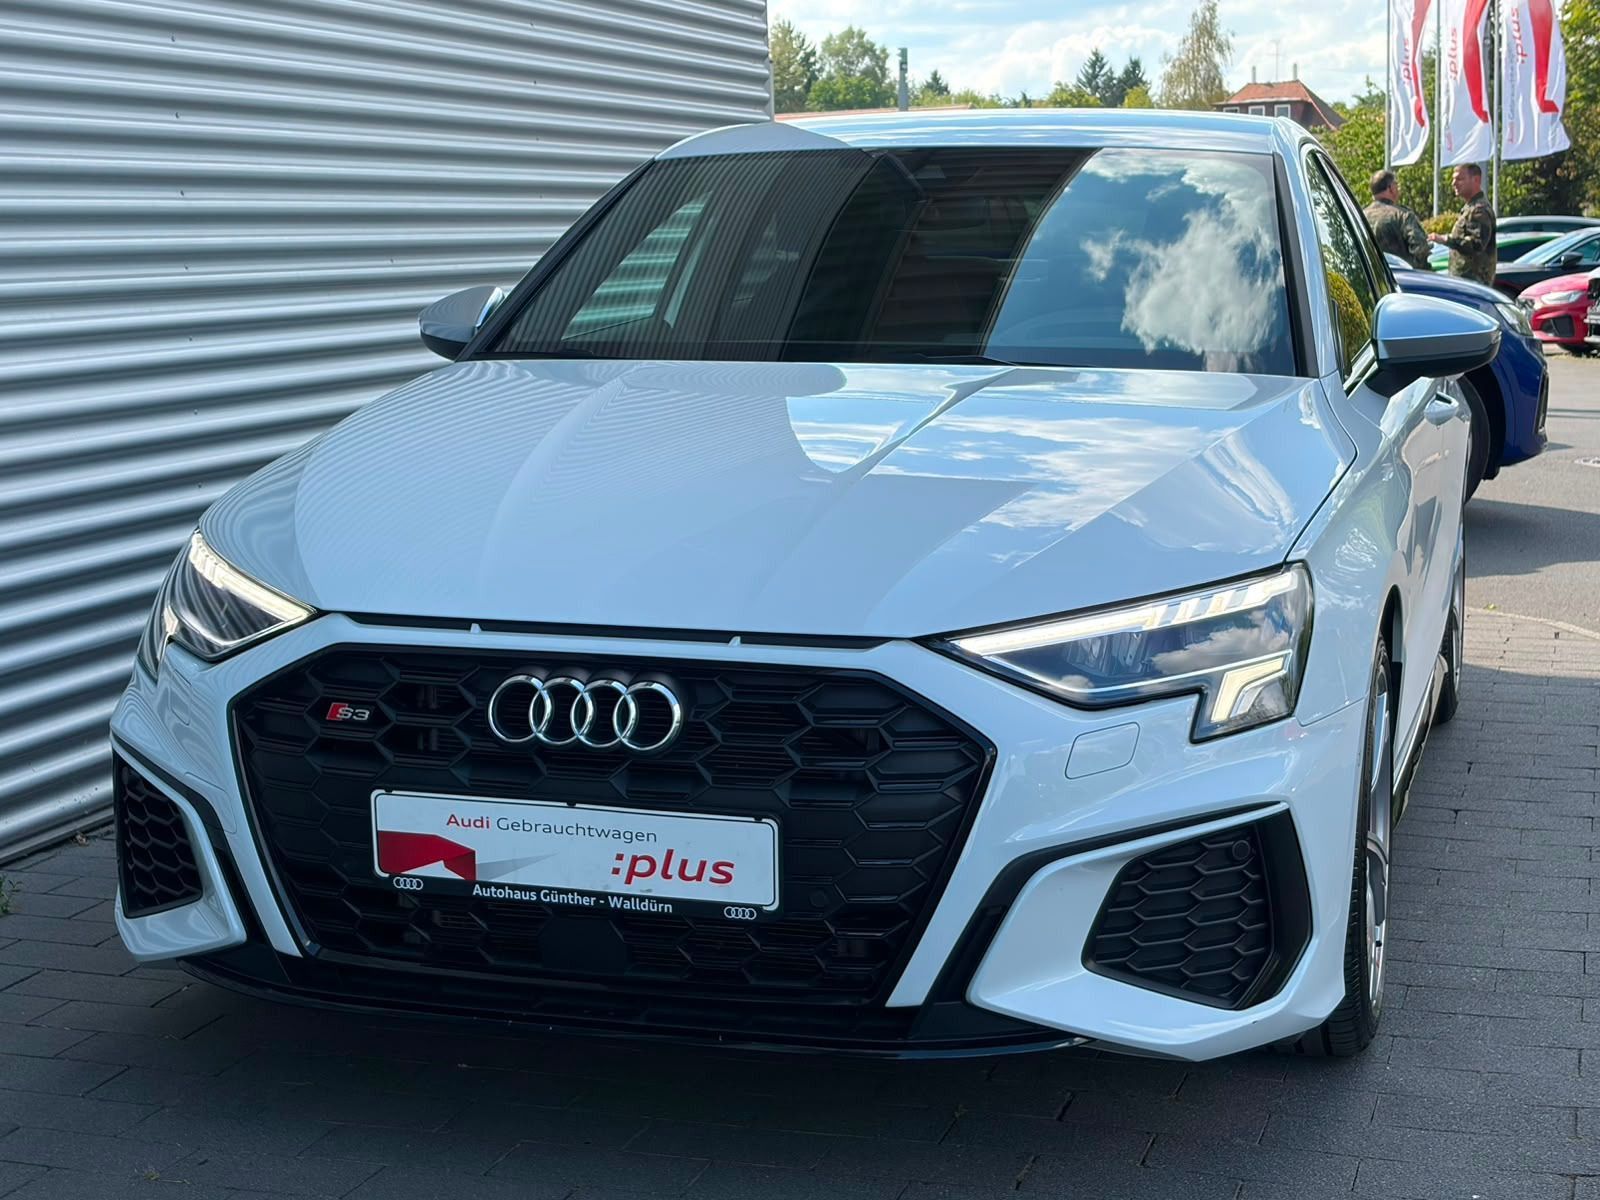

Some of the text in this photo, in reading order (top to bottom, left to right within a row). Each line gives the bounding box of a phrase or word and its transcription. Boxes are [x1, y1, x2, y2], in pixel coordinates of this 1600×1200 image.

[336, 707, 370, 721] S3
[446, 813, 657, 844] Audi Gebrauchtwagen
[472, 884, 537, 901] Autohaus
[540, 889, 596, 906] Günther
[608, 895, 673, 913] Walldürn
